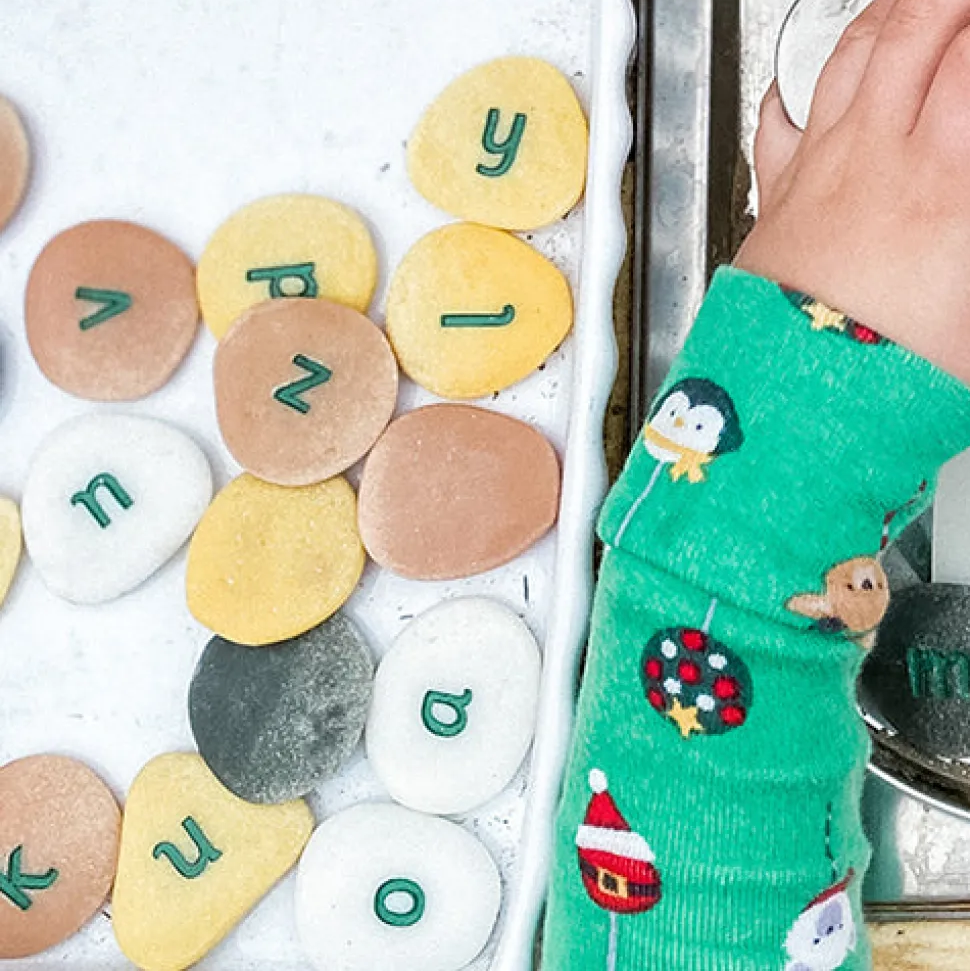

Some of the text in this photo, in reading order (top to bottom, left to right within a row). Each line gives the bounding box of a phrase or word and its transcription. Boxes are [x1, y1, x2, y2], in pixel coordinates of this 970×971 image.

[475, 107, 527, 178] y
[69, 470, 134, 531] n
[420, 687, 473, 738] a
[152, 815, 223, 879] u
[373, 877, 426, 928] o
